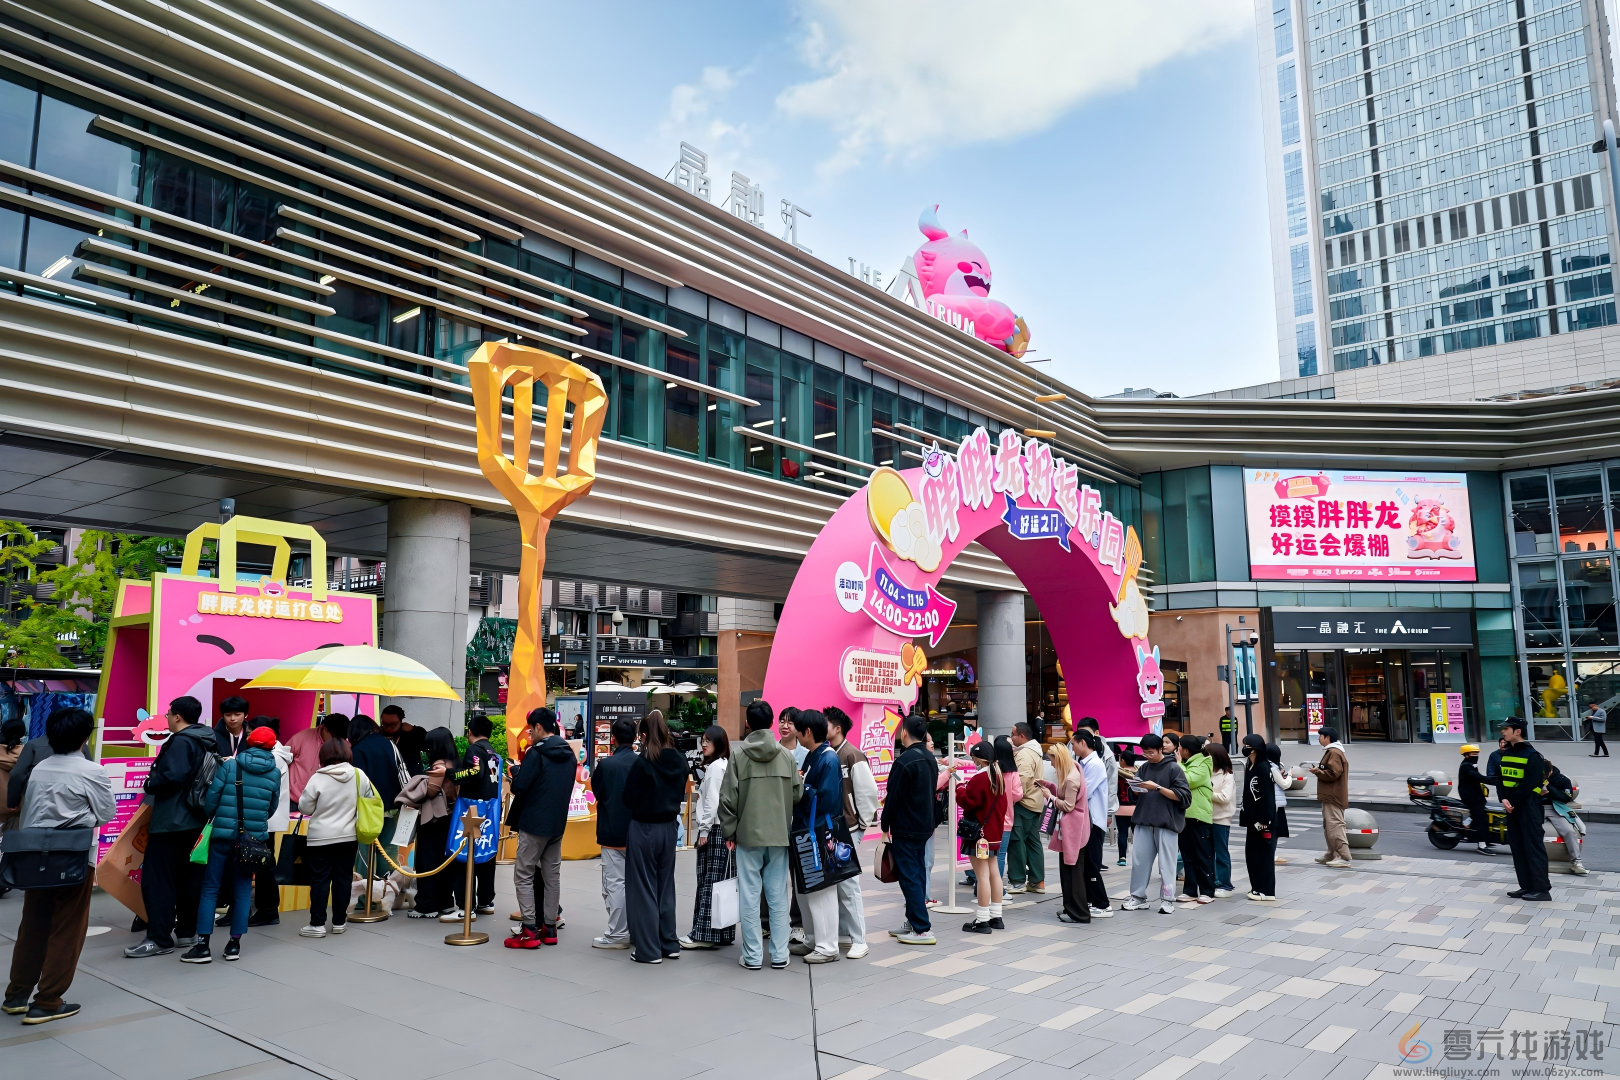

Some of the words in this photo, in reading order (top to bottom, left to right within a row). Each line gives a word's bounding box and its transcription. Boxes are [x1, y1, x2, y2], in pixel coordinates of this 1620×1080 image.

[674, 140, 813, 254] 晶融汇
[847, 256, 882, 290] THE
[919, 426, 1125, 575] 胖胖龙好运乐园
[1019, 513, 1060, 535] 好运之门
[1269, 500, 1402, 529] 摸摸胖胖龙
[1271, 532, 1390, 557] 好运会爆棚
[838, 578, 864, 592] 活动时间
[844, 591, 859, 601] DATE
[879, 573, 899, 601] 11.04
[907, 592, 924, 607] 11.16
[200, 593, 342, 621] 胖胖龙好运打包处
[869, 588, 940, 631] 14:00-22:00
[1319, 621, 1367, 634] 晶融汇
[1390, 619, 1429, 634] ATRIUM
[600, 655, 617, 663] FF
